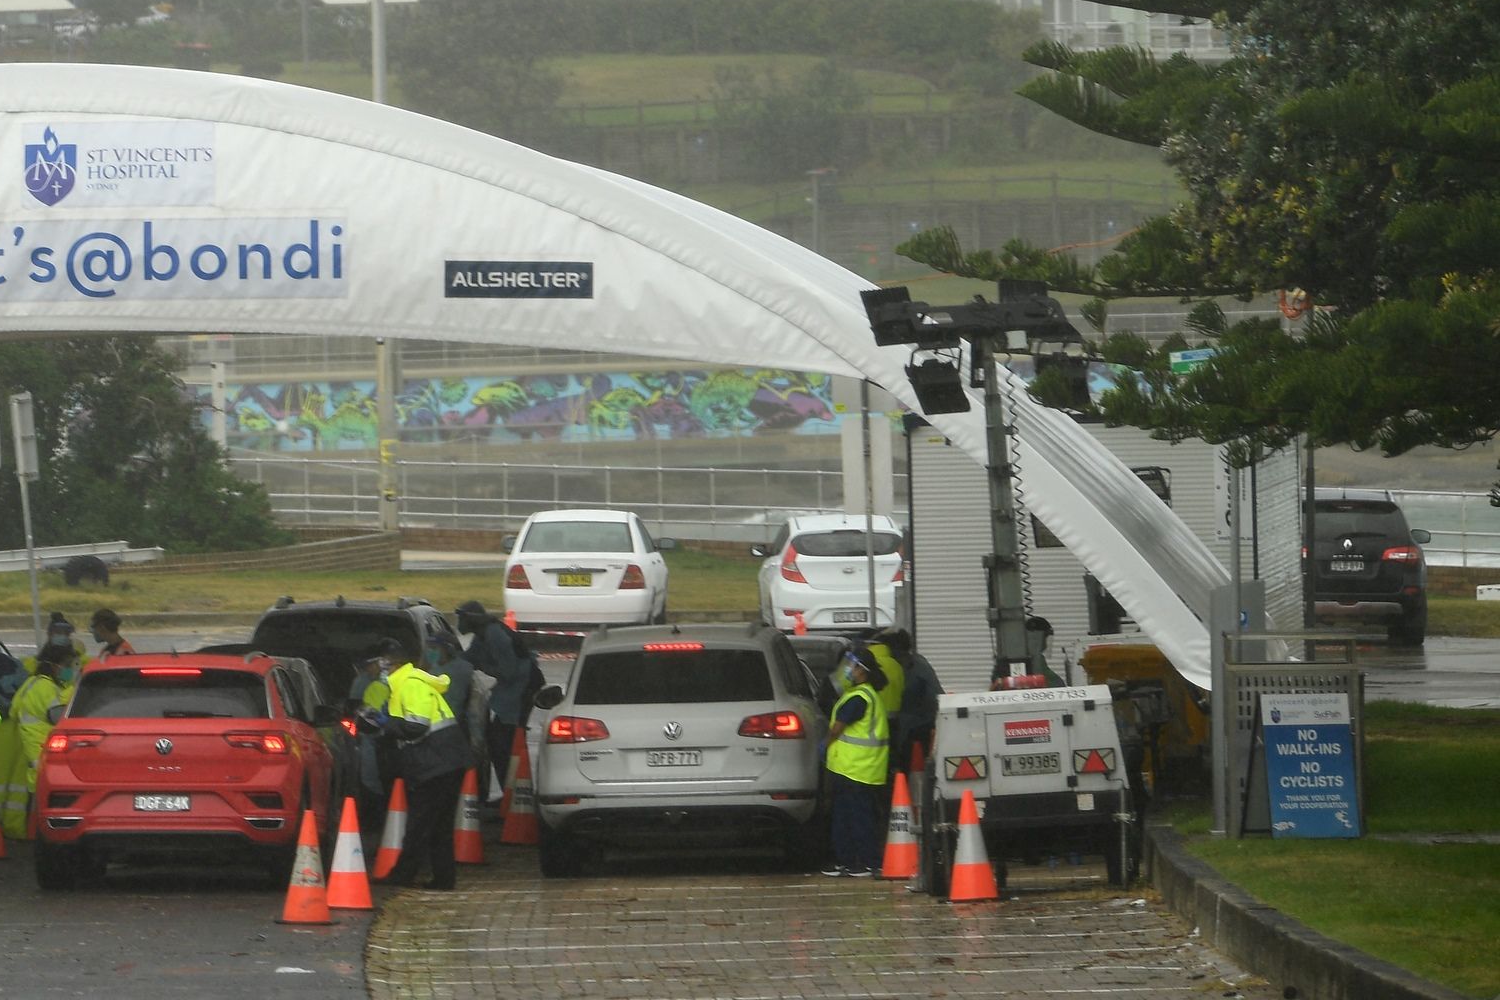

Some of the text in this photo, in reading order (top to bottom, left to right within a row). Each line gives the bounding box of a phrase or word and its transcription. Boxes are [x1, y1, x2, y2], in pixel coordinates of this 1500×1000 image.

[86, 147, 213, 164] ST VINCENT'S
[87, 164, 181, 180] HOSPITAL
[1297, 729, 1318, 741] NO
[1276, 743, 1342, 756] WALK-INS
[1300, 762, 1320, 774] NO
[1280, 775, 1344, 788] CYCLISTS
